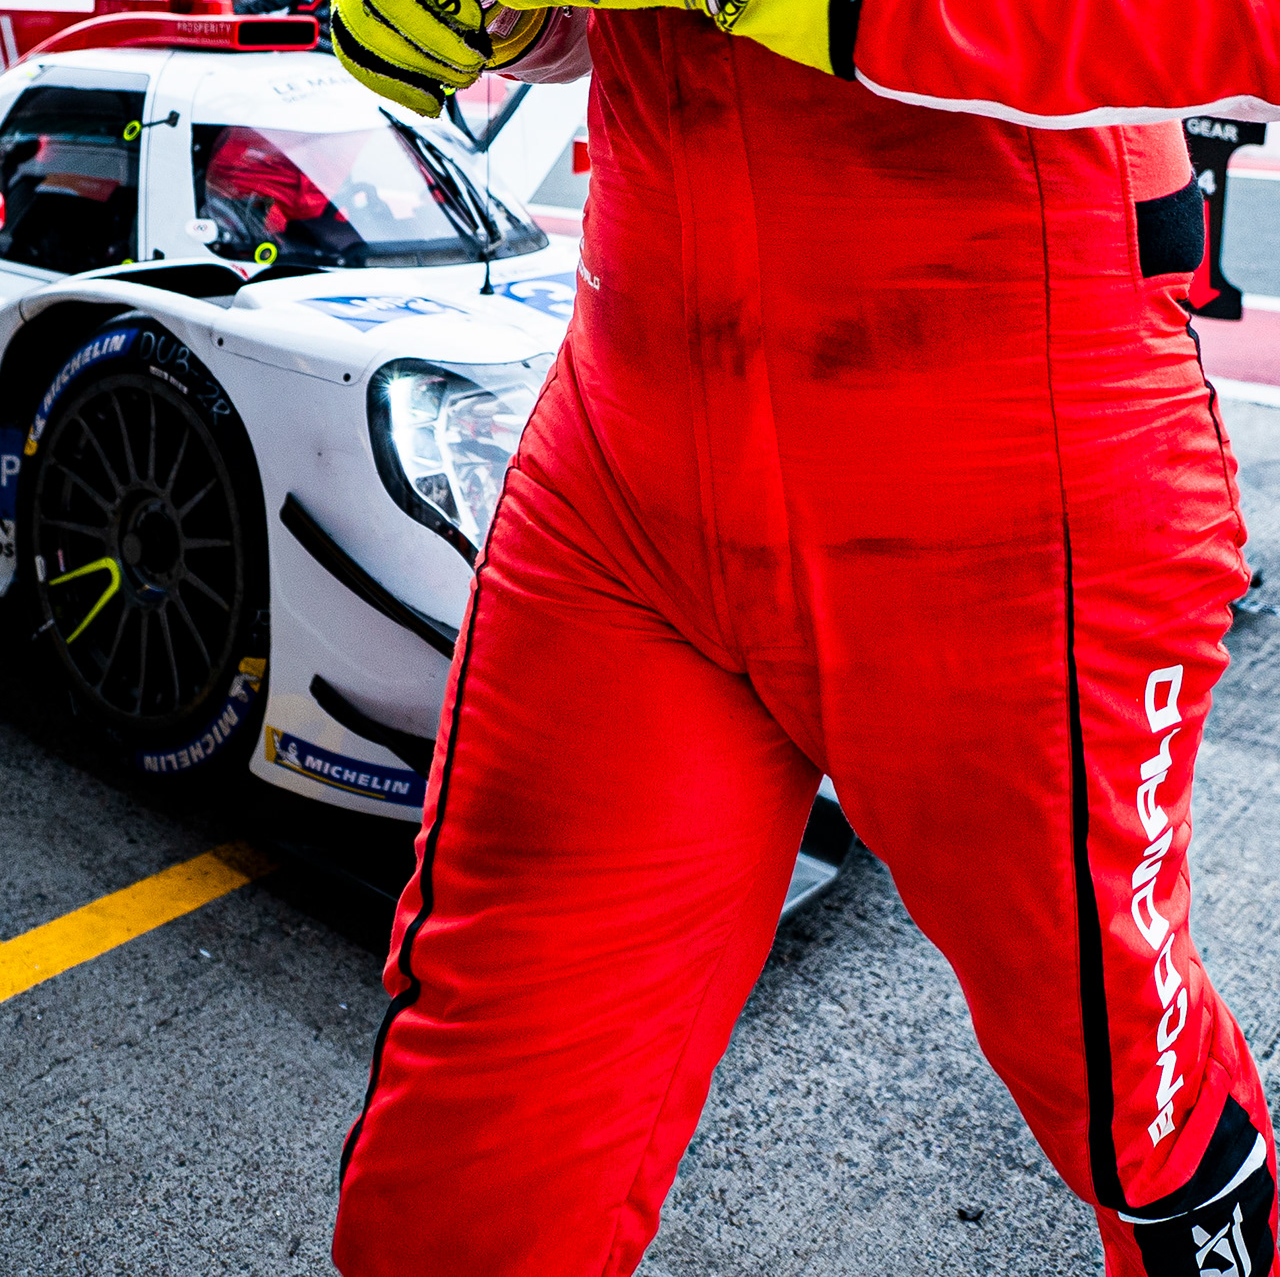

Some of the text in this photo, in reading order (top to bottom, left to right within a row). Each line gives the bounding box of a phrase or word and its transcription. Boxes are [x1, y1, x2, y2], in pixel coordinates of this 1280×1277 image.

[177, 22, 232, 35] PROSPERITY
[1186, 117, 1240, 143] GEAR
[43, 333, 127, 412] MICHELIN
[143, 704, 240, 773] MICHELIN
[303, 754, 411, 795] MICHELIN
